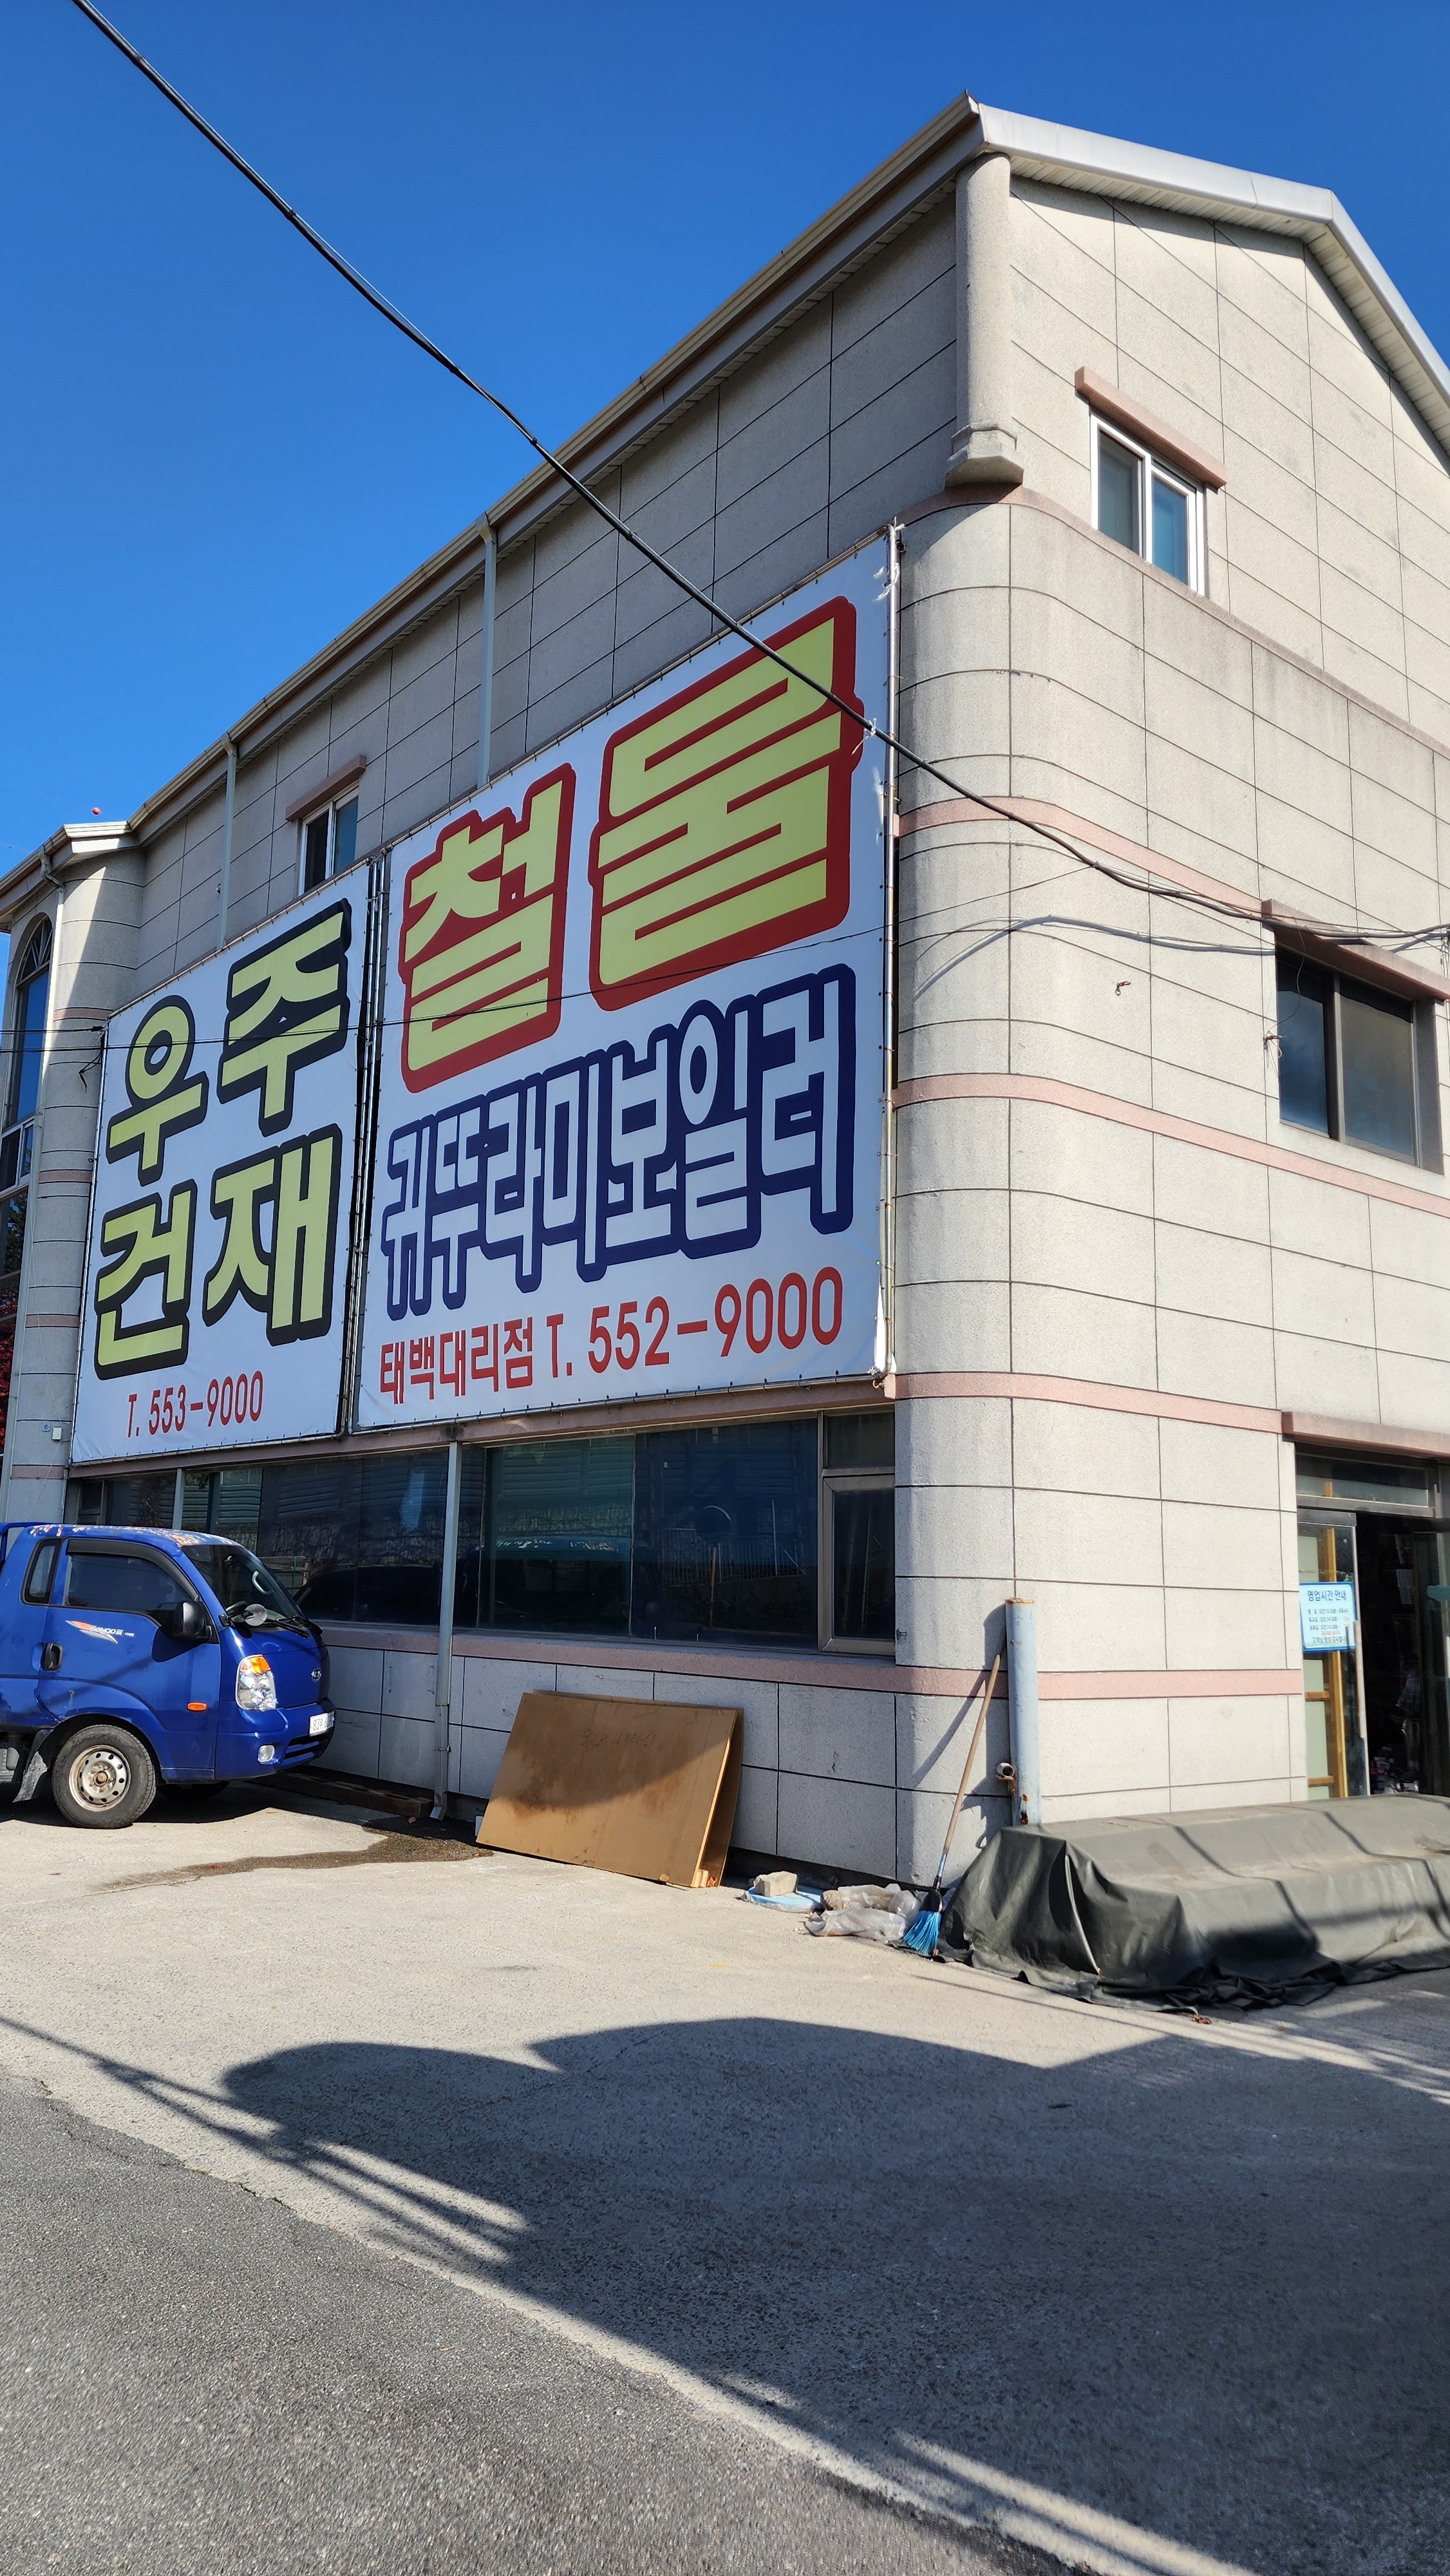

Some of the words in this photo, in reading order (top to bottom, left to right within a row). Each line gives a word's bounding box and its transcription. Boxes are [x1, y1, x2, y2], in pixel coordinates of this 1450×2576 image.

[399, 595, 865, 1094] 철물
[106, 898, 352, 1187] 우주
[94, 1123, 343, 1381] 건재
[380, 1316, 533, 1405] 태백대리점
[588, 1266, 843, 1374] 552-9000
[148, 1370, 263, 1435] 553-9000
[1307, 1589, 1333, 1602] 영업시간
[1334, 1589, 1347, 1601] 안내
